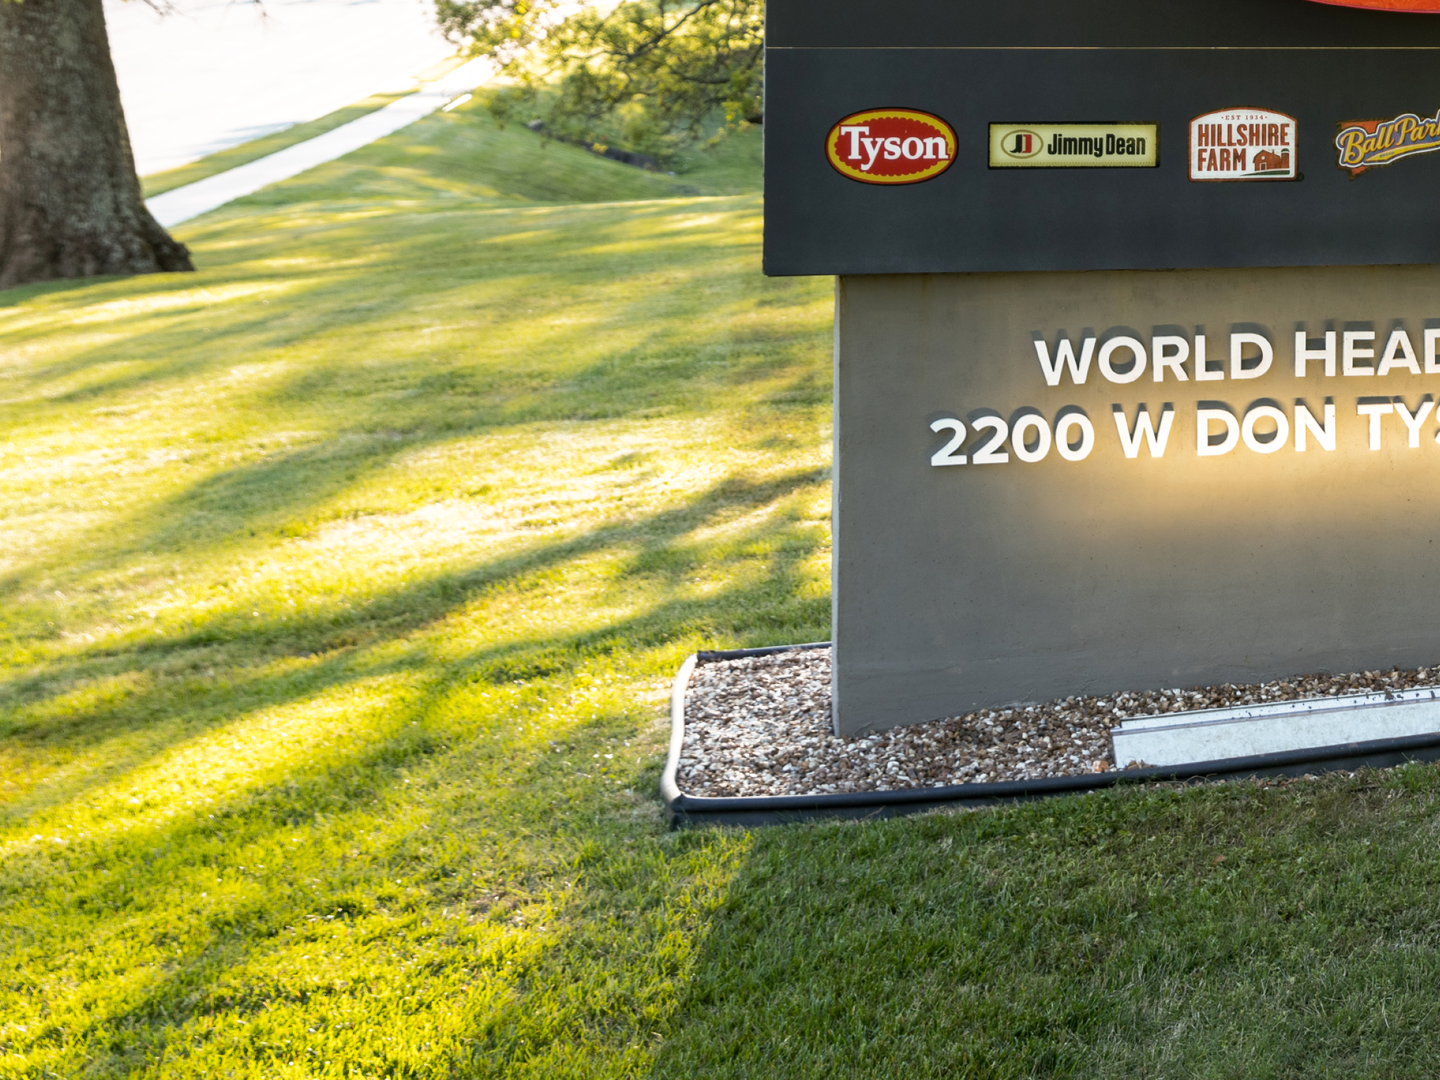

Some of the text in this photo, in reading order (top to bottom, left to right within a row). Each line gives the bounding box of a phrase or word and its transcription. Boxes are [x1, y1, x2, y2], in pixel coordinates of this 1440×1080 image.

[841, 126, 949, 171] Tyson
[1047, 133, 1146, 158] Jimmy Dean
[1197, 123, 1290, 147] HILLSHIRE
[1339, 124, 1395, 164] Ball
[1197, 148, 1247, 172] FARM
[1033, 332, 1274, 386] WORLD
[929, 412, 1095, 467] 2200
[1113, 409, 1175, 459] W
[1196, 404, 1337, 457] DON
